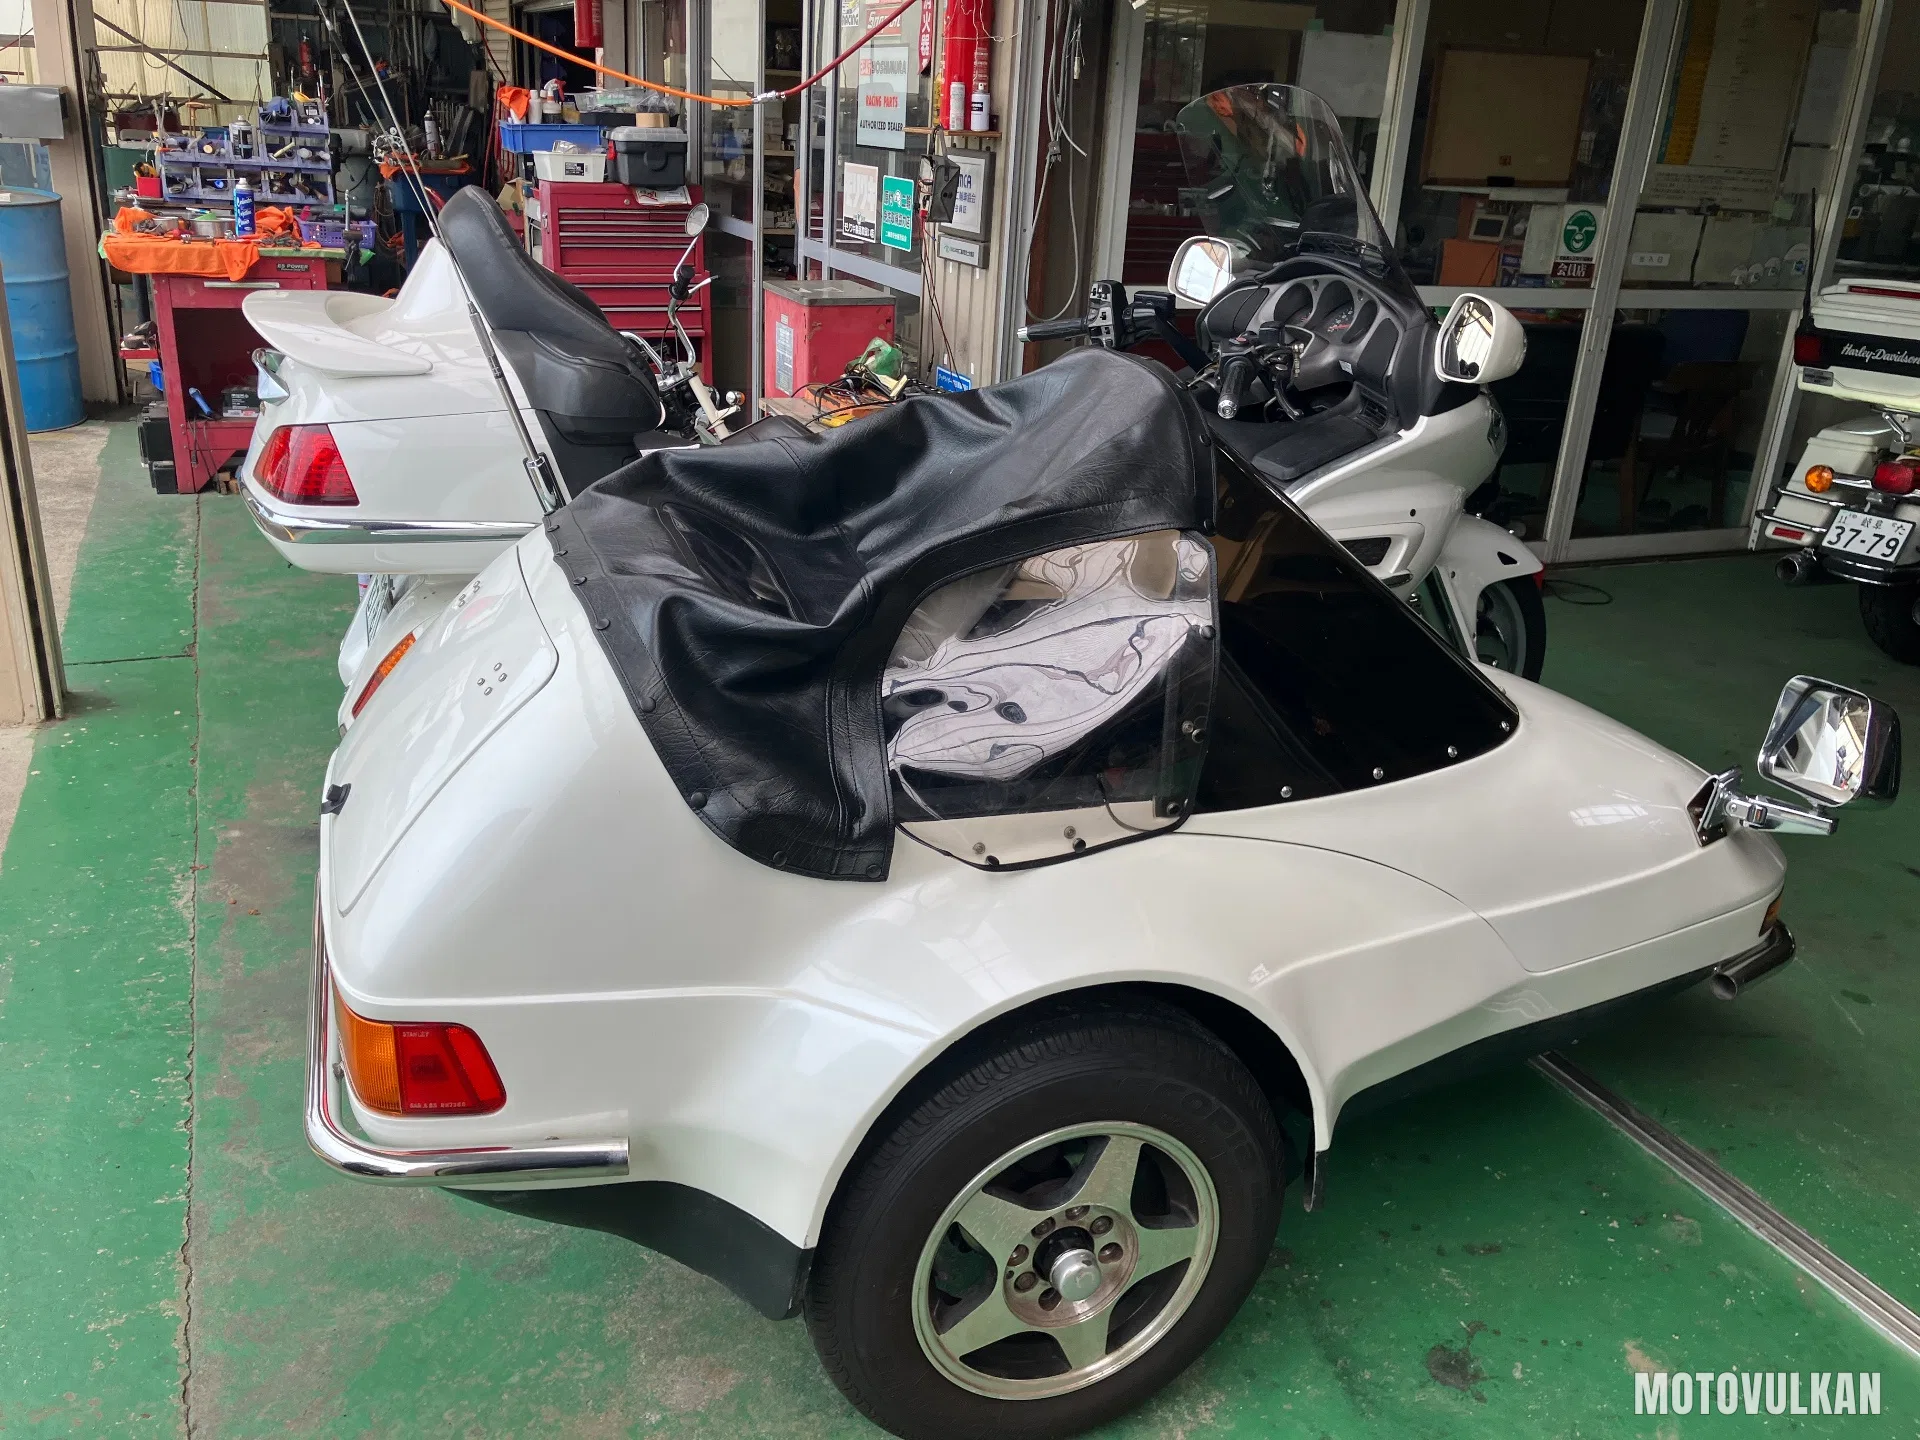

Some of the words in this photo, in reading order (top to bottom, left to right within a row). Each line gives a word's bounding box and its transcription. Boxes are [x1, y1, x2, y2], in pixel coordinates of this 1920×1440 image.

[872, 60, 907, 75] YOSHIMURA
[866, 95, 881, 106] RACING
[883, 96, 898, 107] PARTS
[860, 120, 887, 131] AUTHORIZED
[888, 122, 904, 131] DEALER
[1841, 342, 1920, 366] Harley-Davidson
[1826, 525, 1900, 558] 37-79
